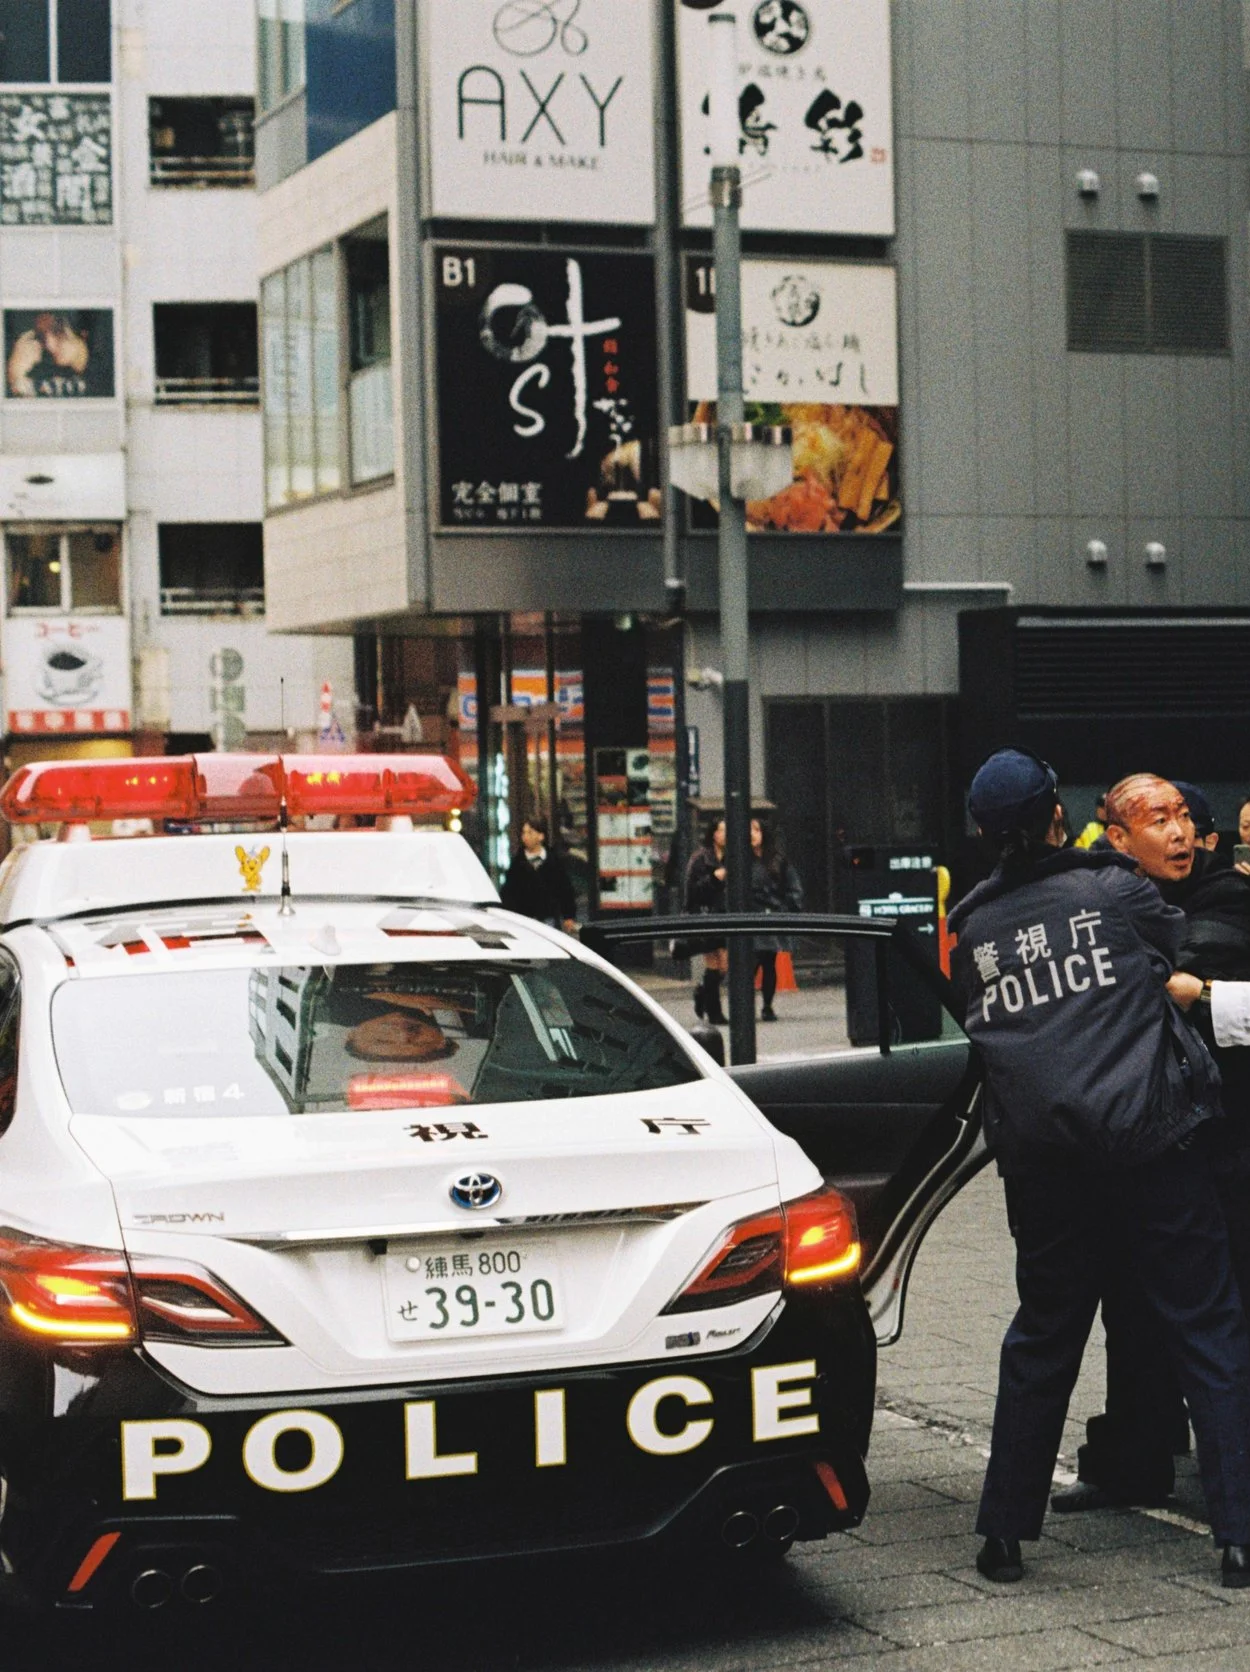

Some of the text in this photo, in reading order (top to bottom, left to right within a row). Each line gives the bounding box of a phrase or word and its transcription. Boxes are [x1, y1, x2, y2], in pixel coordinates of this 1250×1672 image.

[457, 65, 623, 148] AXY
[483, 151, 526, 166] HAIR
[549, 154, 599, 170] MAKE
[442, 256, 476, 287] B1
[451, 480, 543, 506] 完全個室
[973, 909, 1102, 983] 警視庁
[982, 946, 1117, 1023] POLICE
[424, 1250, 521, 1280] 練馬 800
[397, 1278, 555, 1330] せ 39-30
[120, 1358, 821, 1502] POLICE
